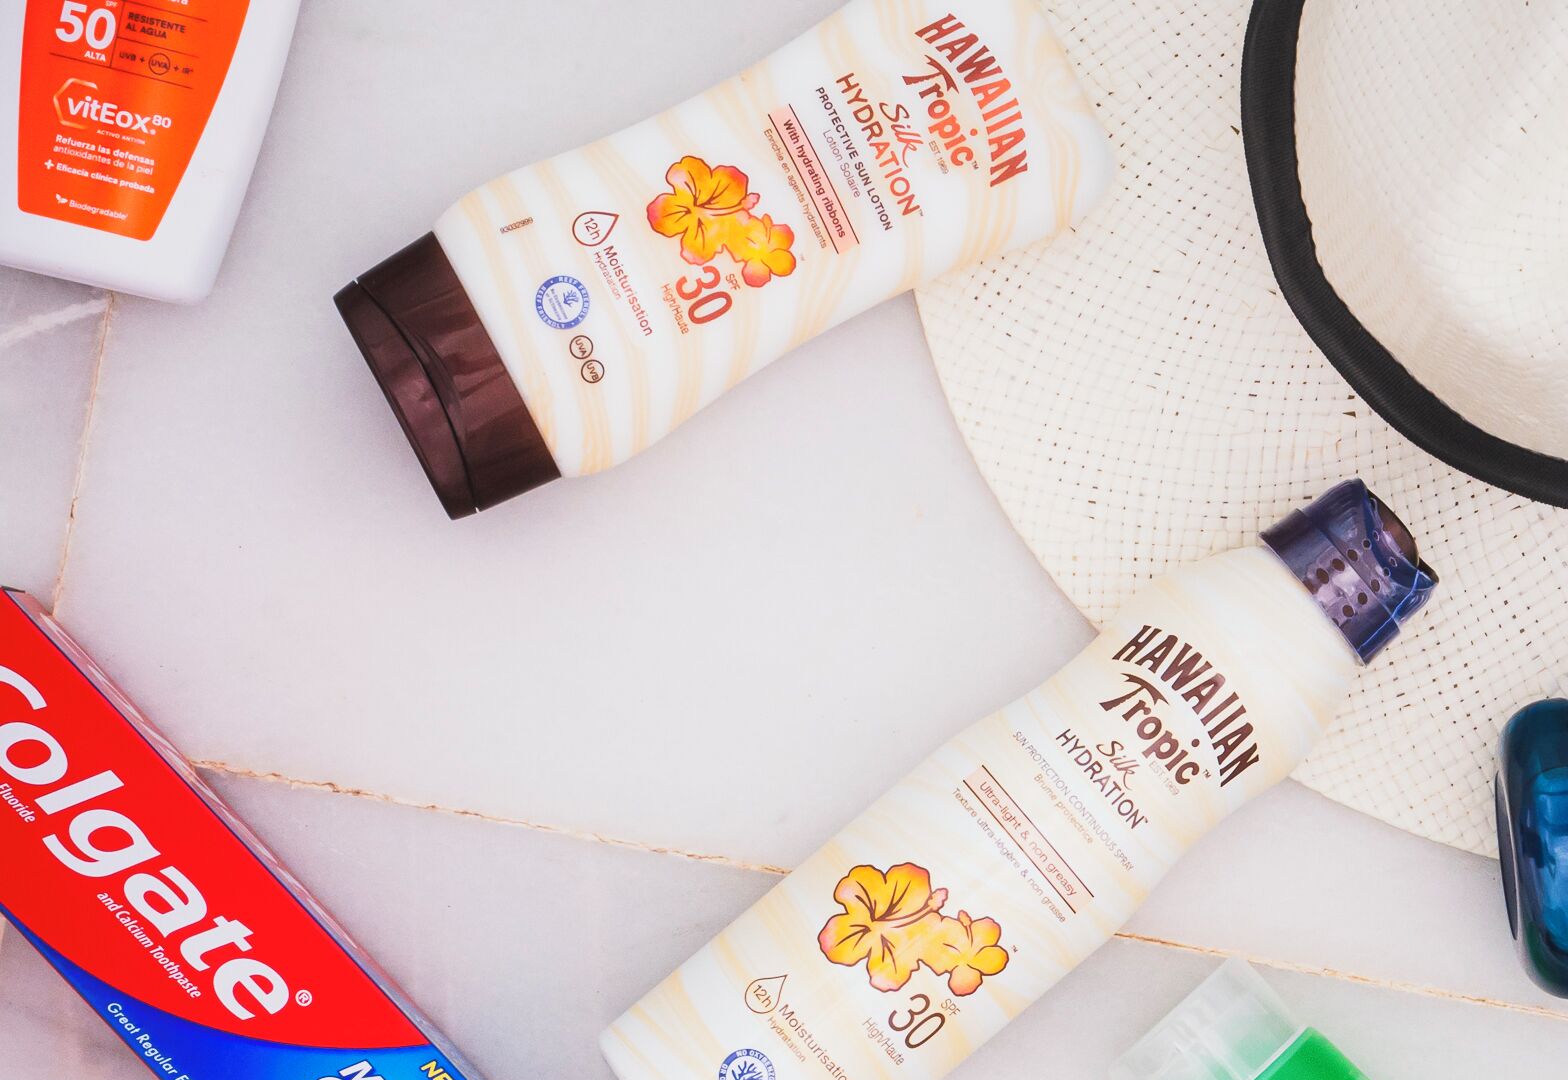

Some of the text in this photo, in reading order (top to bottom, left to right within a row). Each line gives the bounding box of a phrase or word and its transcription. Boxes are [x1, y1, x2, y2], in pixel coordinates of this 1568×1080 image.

[55, 0, 116, 50] 50
[126, 22, 167, 38] AL AGUA
[128, 12, 185, 33] RESISTENTE
[84, 50, 106, 62] ALTA
[914, 13, 1028, 187] HAWAIIAN
[815, 87, 893, 231] PROTECTIVE SUN LOTION
[870, 102, 923, 166] Silk
[783, 119, 846, 238] With hydrating ribbons
[584, 216, 603, 241] 12h
[603, 245, 653, 336] Moisturisation
[675, 265, 733, 324] 30
[725, 273, 741, 290] SPF
[662, 283, 689, 334] High/Haute
[1112, 625, 1259, 787] HAWAIIAN
[1096, 740, 1140, 789] Silk
[0, 783, 36, 822] Fluoride
[980, 781, 1077, 896] Ultra-light & non greasy
[97, 892, 201, 998] and Calcium Toothpaste
[753, 984, 771, 1008] 12h
[888, 993, 946, 1049] 30
[940, 998, 961, 1017] SPF
[107, 1002, 141, 1034] Great
[136, 1033, 178, 1074] Regular
[862, 1017, 905, 1066] High/Haute
